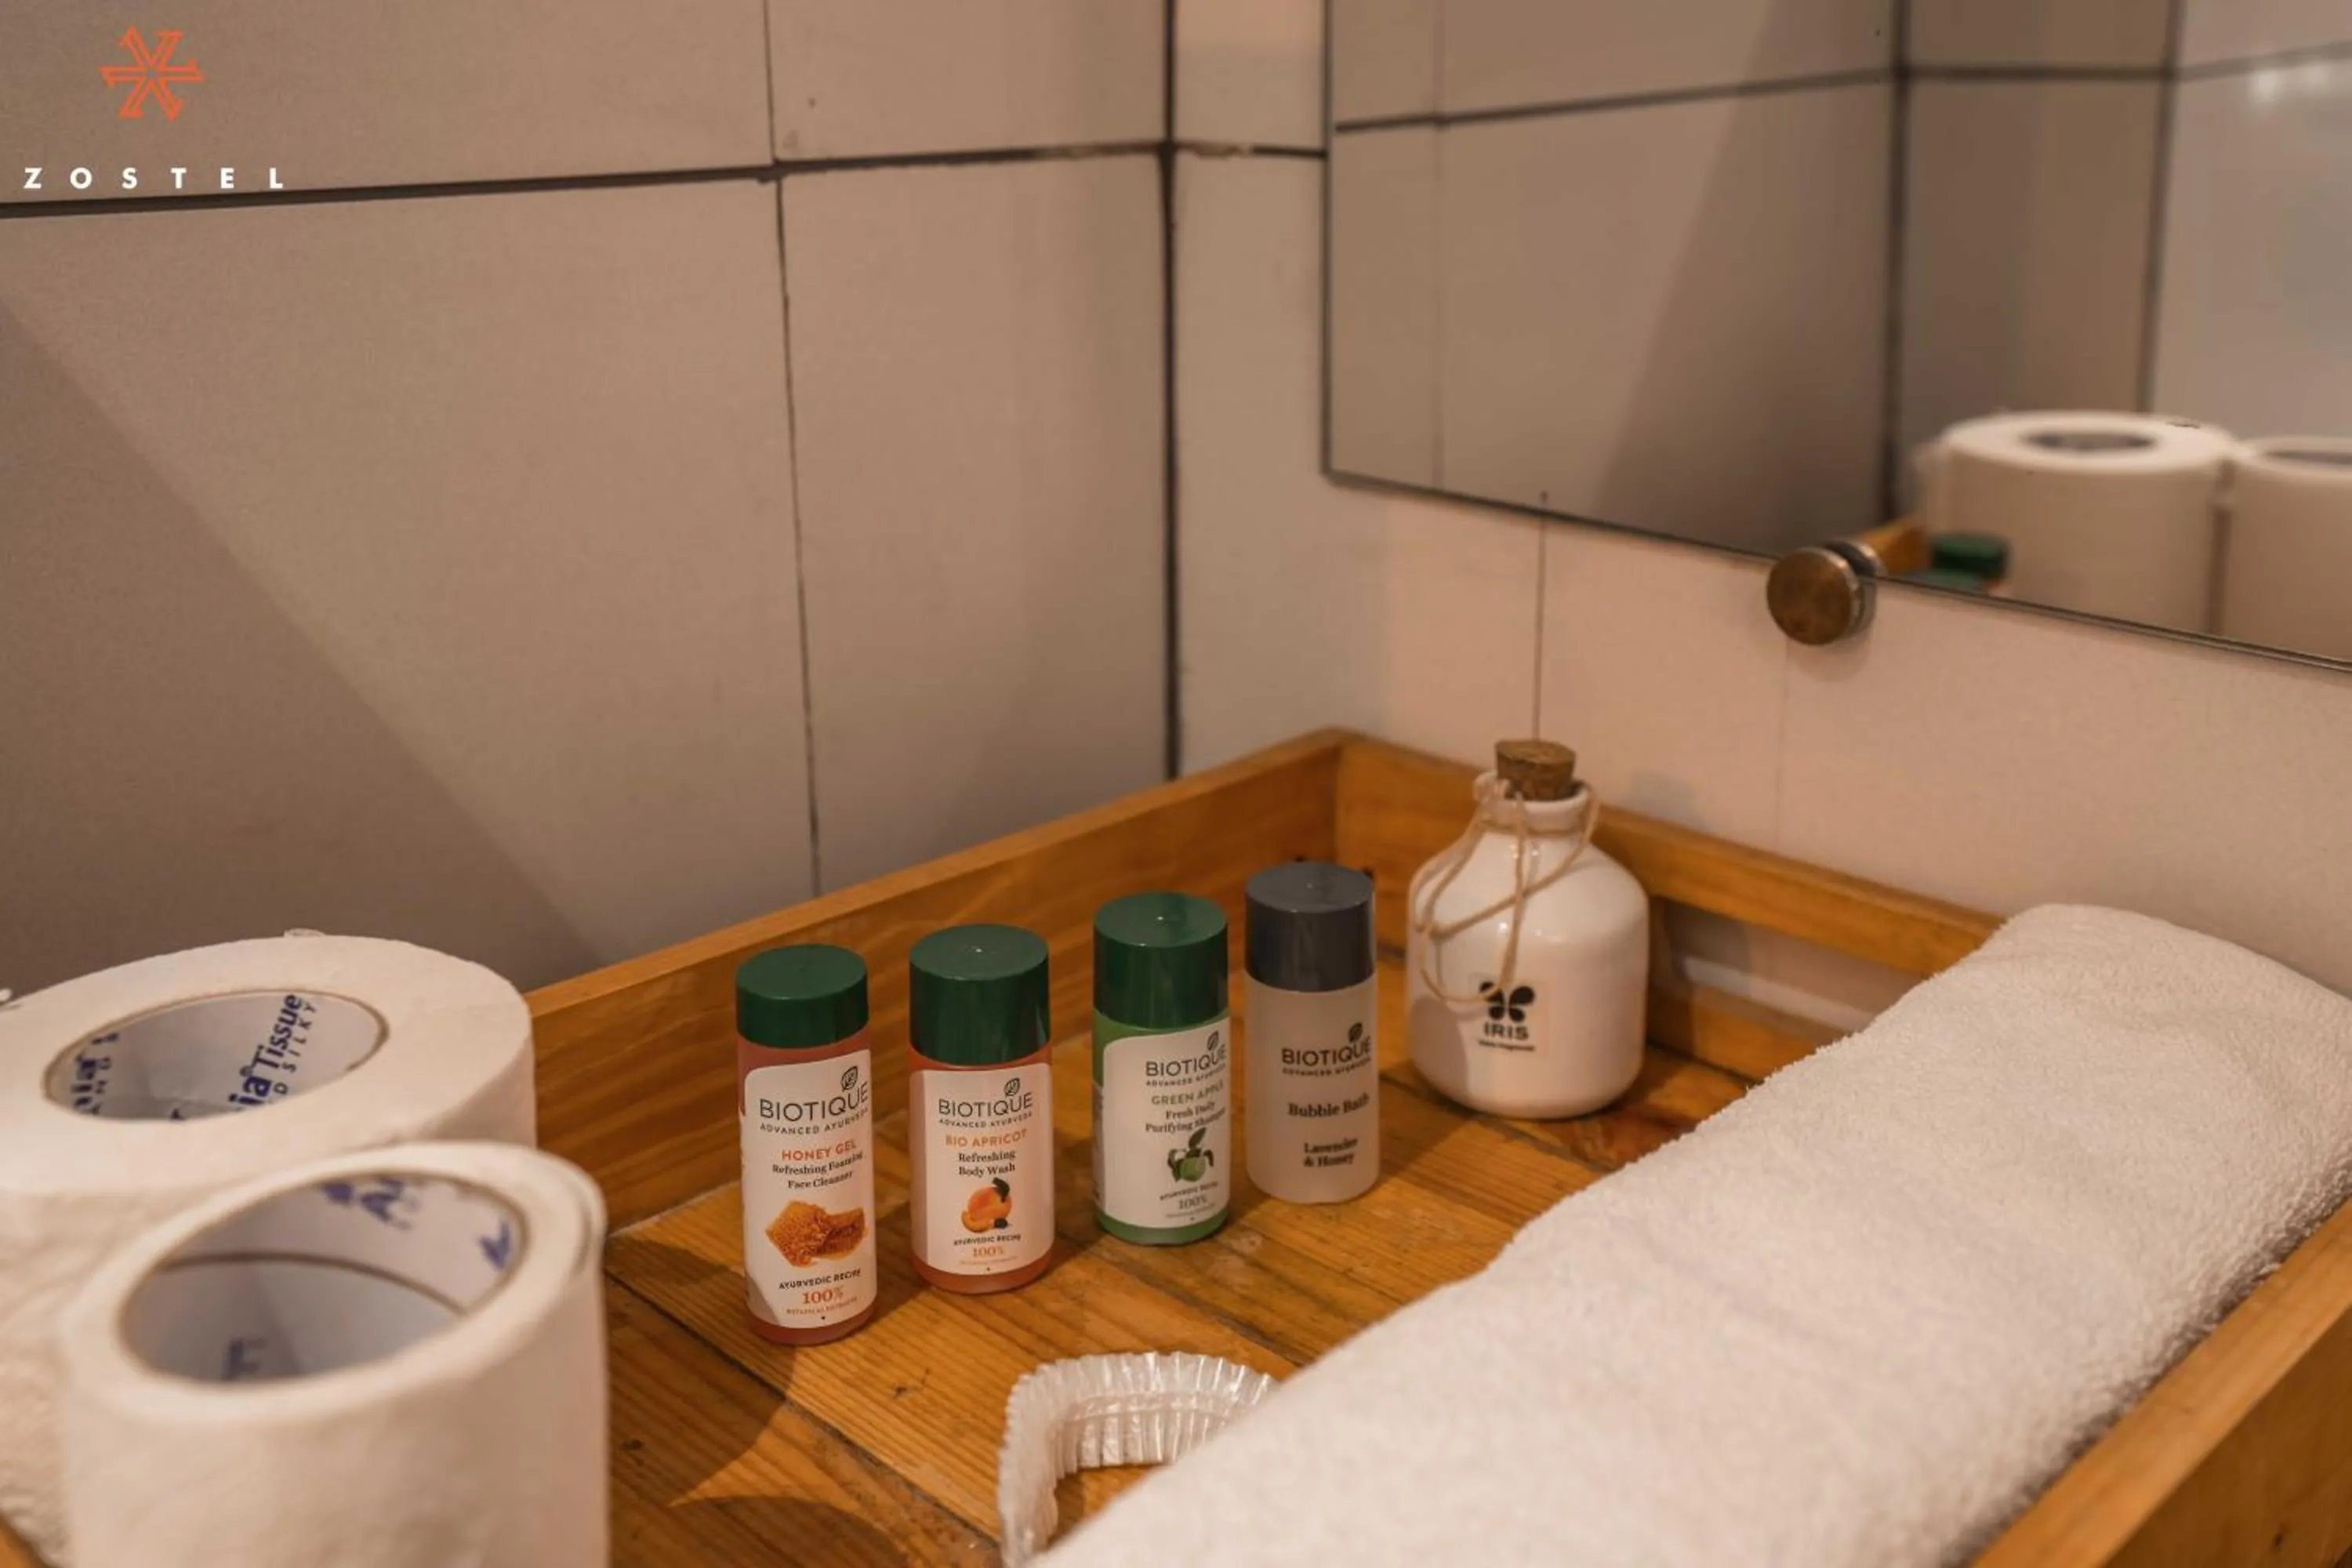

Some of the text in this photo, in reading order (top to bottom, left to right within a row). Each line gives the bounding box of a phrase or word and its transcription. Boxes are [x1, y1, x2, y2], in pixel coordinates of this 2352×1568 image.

[251, 994, 302, 1069] Tissue
[282, 1003, 316, 1074] SILKY
[1484, 1022, 1530, 1041] IRIS
[1282, 1036, 1371, 1066] BIOTIQUE
[1145, 1044, 1226, 1076] BIOTIQUE
[760, 1080, 869, 1122] BIOTIQUE
[938, 1091, 1033, 1117] BIOTIQUE
[1151, 1094, 1194, 1105] GREEN
[1166, 1107, 1193, 1120] Fresh
[1287, 1102, 1340, 1119] Bubble
[939, 1111, 1032, 1128] ADVANCED AYURVEDA
[760, 1123, 819, 1134] ADVANCED
[1145, 1123, 1193, 1134] Purifying
[945, 1129, 1027, 1147] BIO APRICOT
[1304, 1138, 1358, 1154] Lavender
[782, 1138, 857, 1161] HONEY GEL
[959, 1150, 1016, 1162] Refreshing
[772, 1164, 827, 1175] Refreshing
[959, 1162, 1016, 1178] Body Wash
[788, 1180, 811, 1189] Face
[779, 1276, 832, 1290] AYURVEDIC
[803, 1285, 844, 1305] 100%
